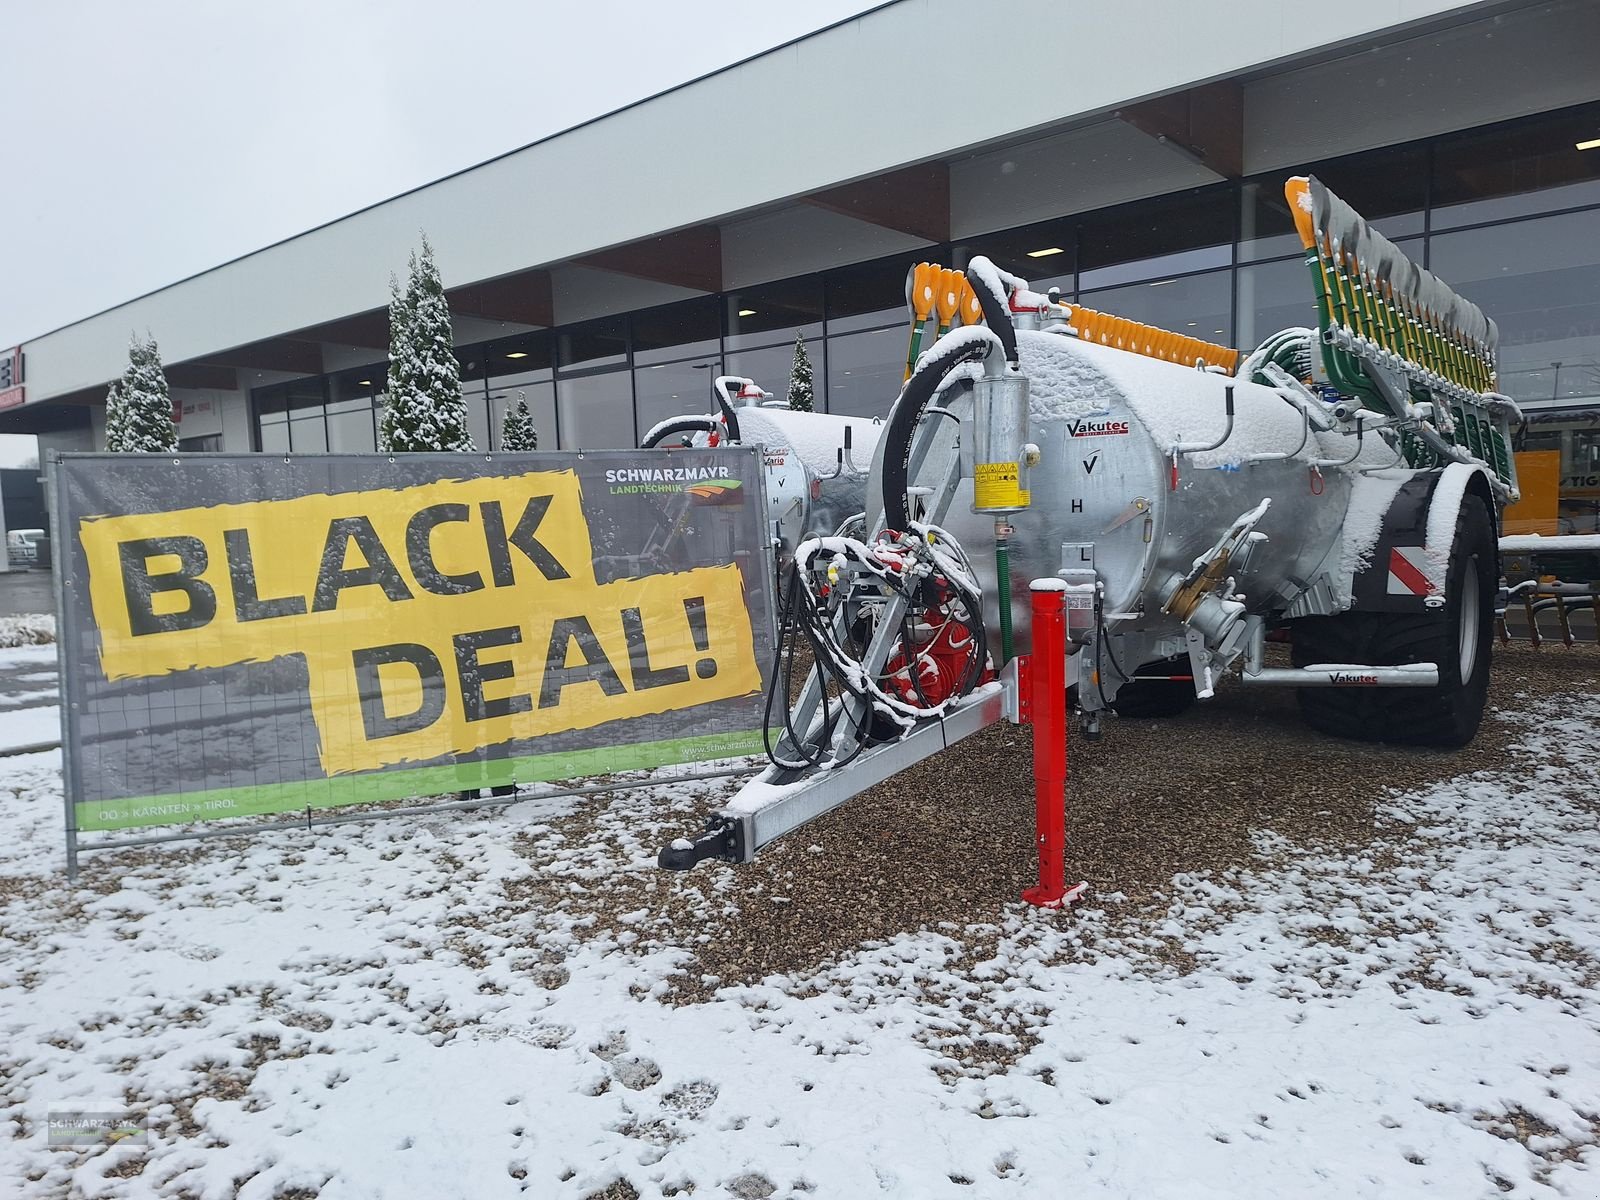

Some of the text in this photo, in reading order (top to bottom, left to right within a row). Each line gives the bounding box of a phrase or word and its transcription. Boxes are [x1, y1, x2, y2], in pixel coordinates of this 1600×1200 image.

[1066, 419, 1129, 437] Vakutec
[1083, 456, 1098, 474] V
[605, 466, 729, 483] SCHWARZMAYR
[609, 484, 683, 495] LANDTECHNIK
[1071, 499, 1083, 513] H
[1081, 547, 1091, 561] L
[118, 494, 571, 637] BLACK
[351, 596, 717, 742] DEAL!
[1329, 672, 1378, 685] Vakutec
[204, 798, 238, 810] TIROL
